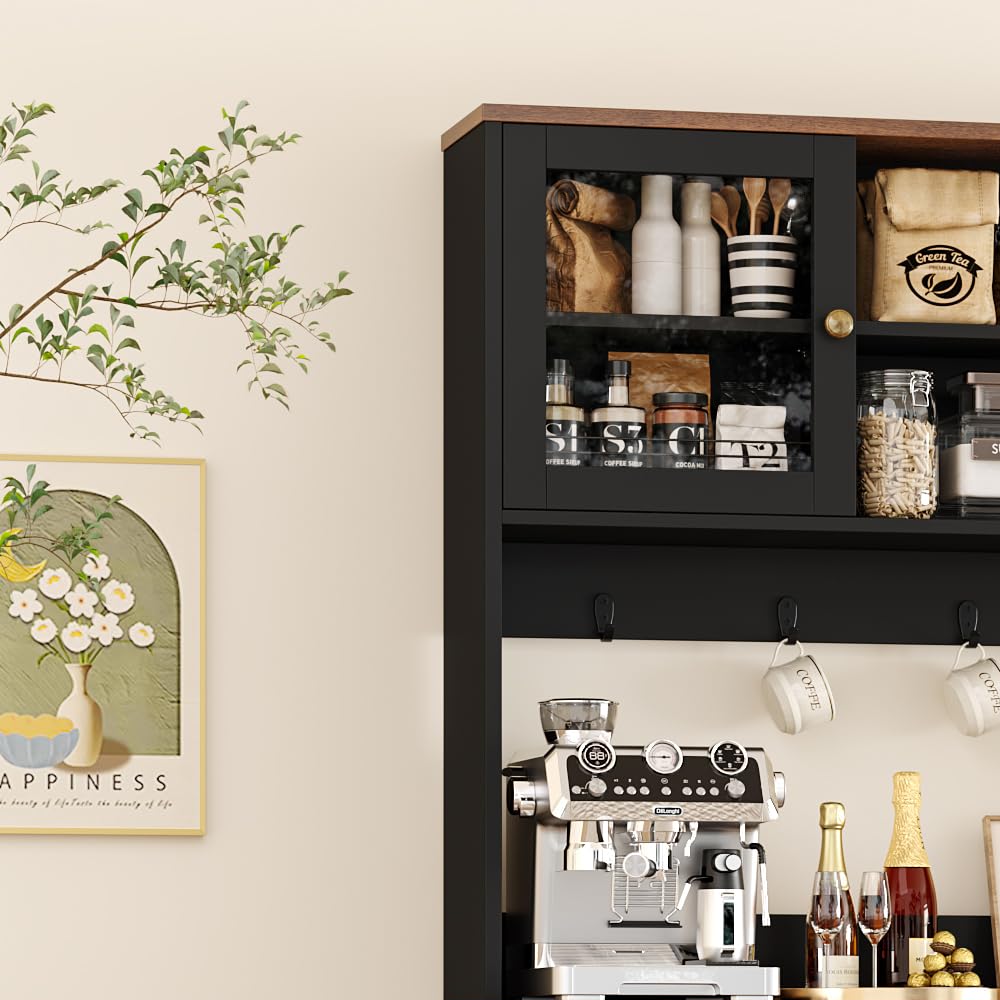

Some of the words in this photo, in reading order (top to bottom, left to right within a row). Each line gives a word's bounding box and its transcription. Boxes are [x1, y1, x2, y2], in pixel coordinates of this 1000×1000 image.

[915, 252, 947, 264] Green
[951, 252, 970, 267] Tea
[602, 425, 644, 454] S3
